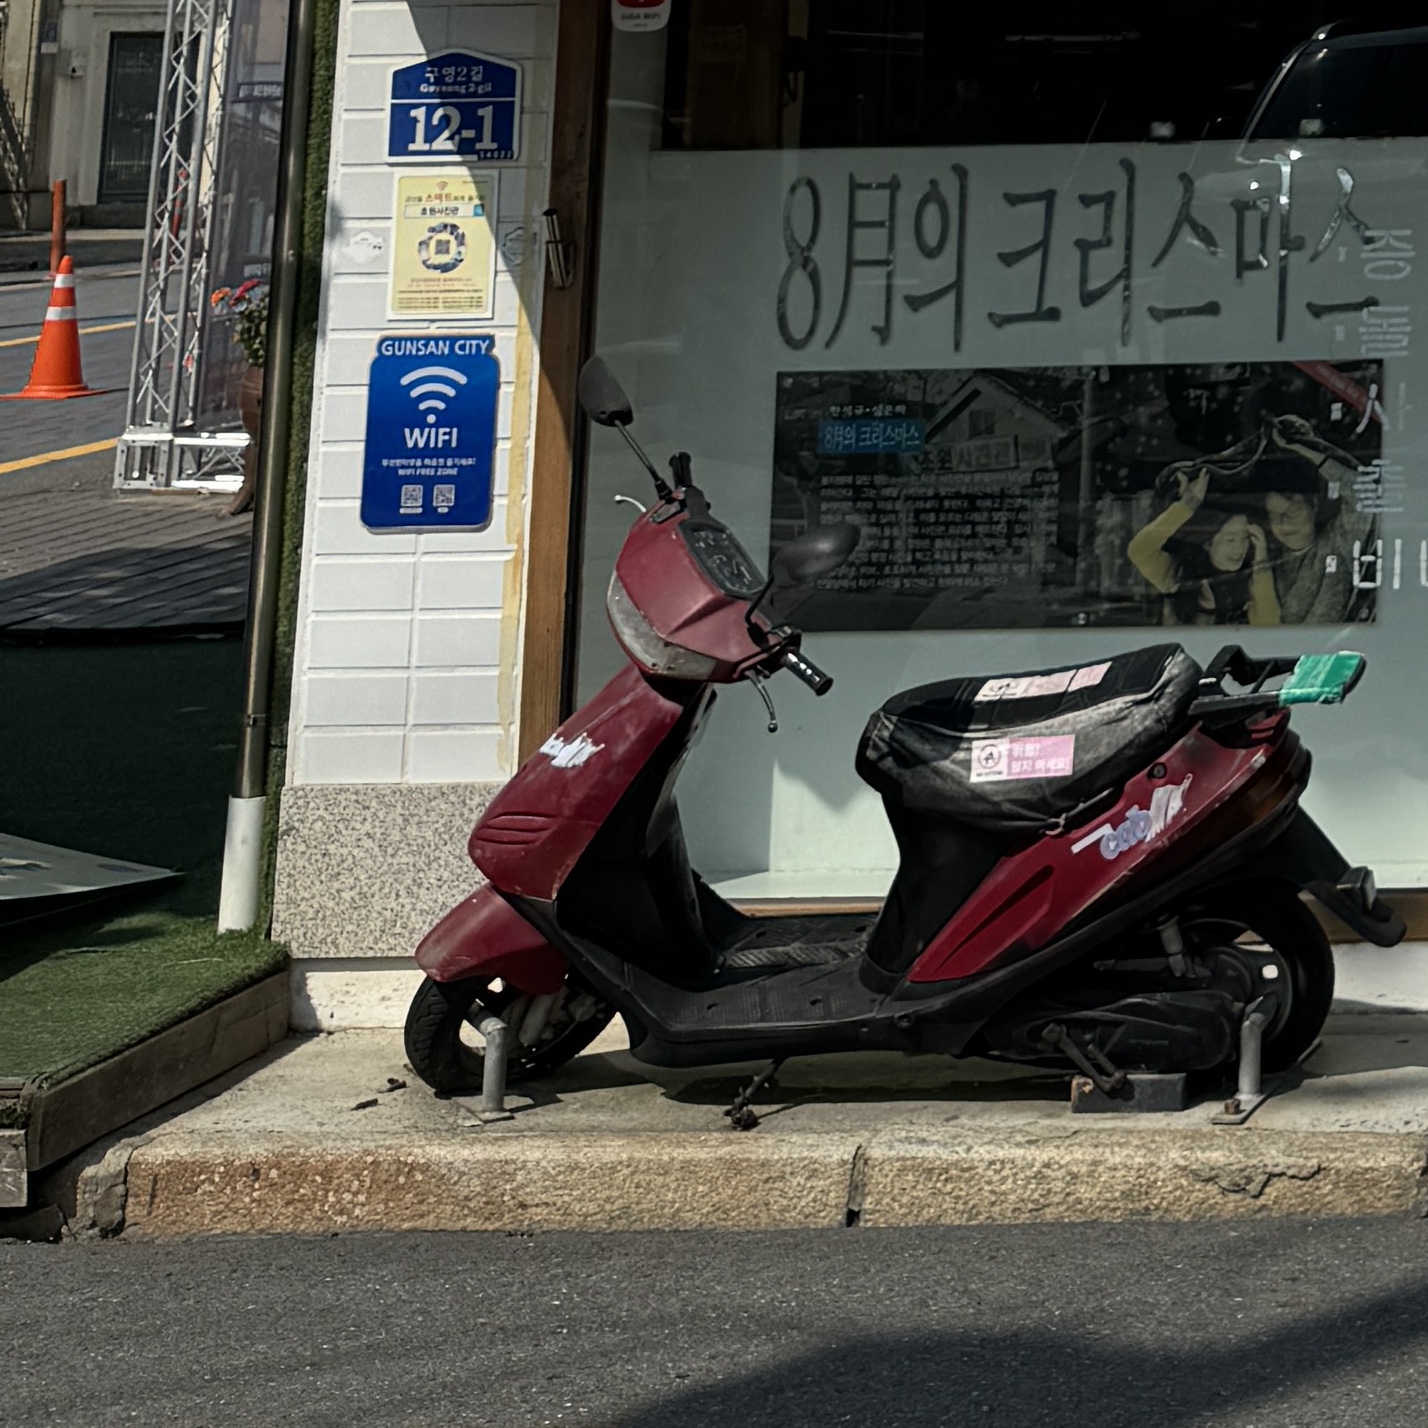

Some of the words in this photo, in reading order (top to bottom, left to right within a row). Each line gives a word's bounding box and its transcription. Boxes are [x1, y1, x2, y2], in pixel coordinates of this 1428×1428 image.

[425, 65, 483, 83] 구영2길
[408, 105, 498, 151] 12-1
[986, 154, 1384, 347] 크리스마스
[381, 339, 450, 356] GUNSAN
[454, 339, 490, 355] CITY
[404, 427, 458, 448] WIFI
